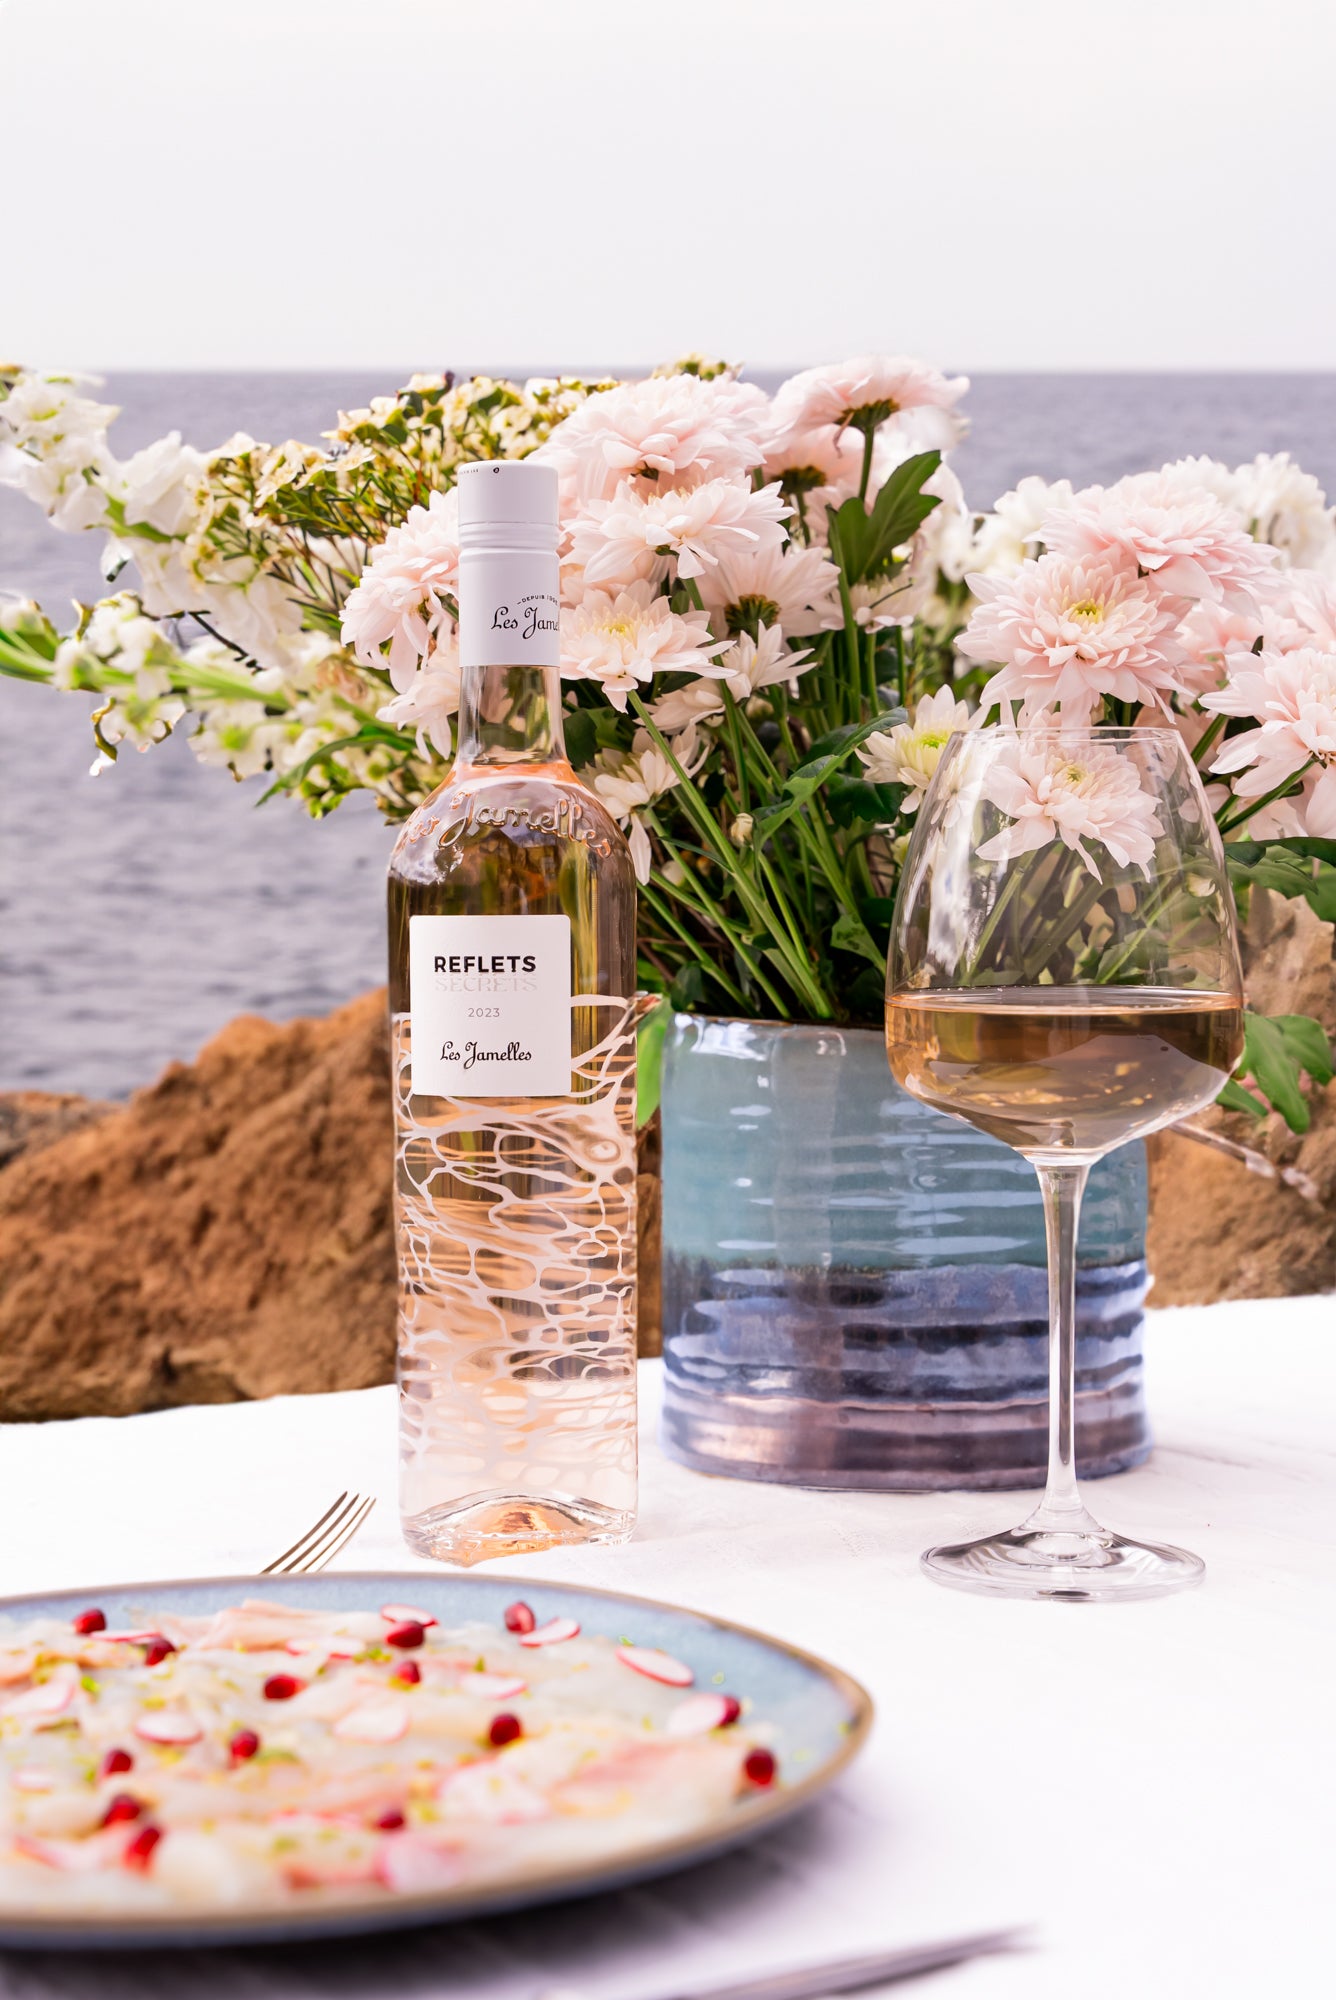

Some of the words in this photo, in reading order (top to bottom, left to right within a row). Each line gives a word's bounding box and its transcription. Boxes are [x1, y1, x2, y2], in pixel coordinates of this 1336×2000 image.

[490, 606, 518, 630] Les
[522, 606, 560, 640] Jame
[434, 955, 537, 973] REFLETS
[435, 977, 538, 992] SECRETS
[467, 1007, 501, 1018] 2023
[440, 1041, 461, 1061] Les
[463, 1041, 532, 1070] Jamelles
